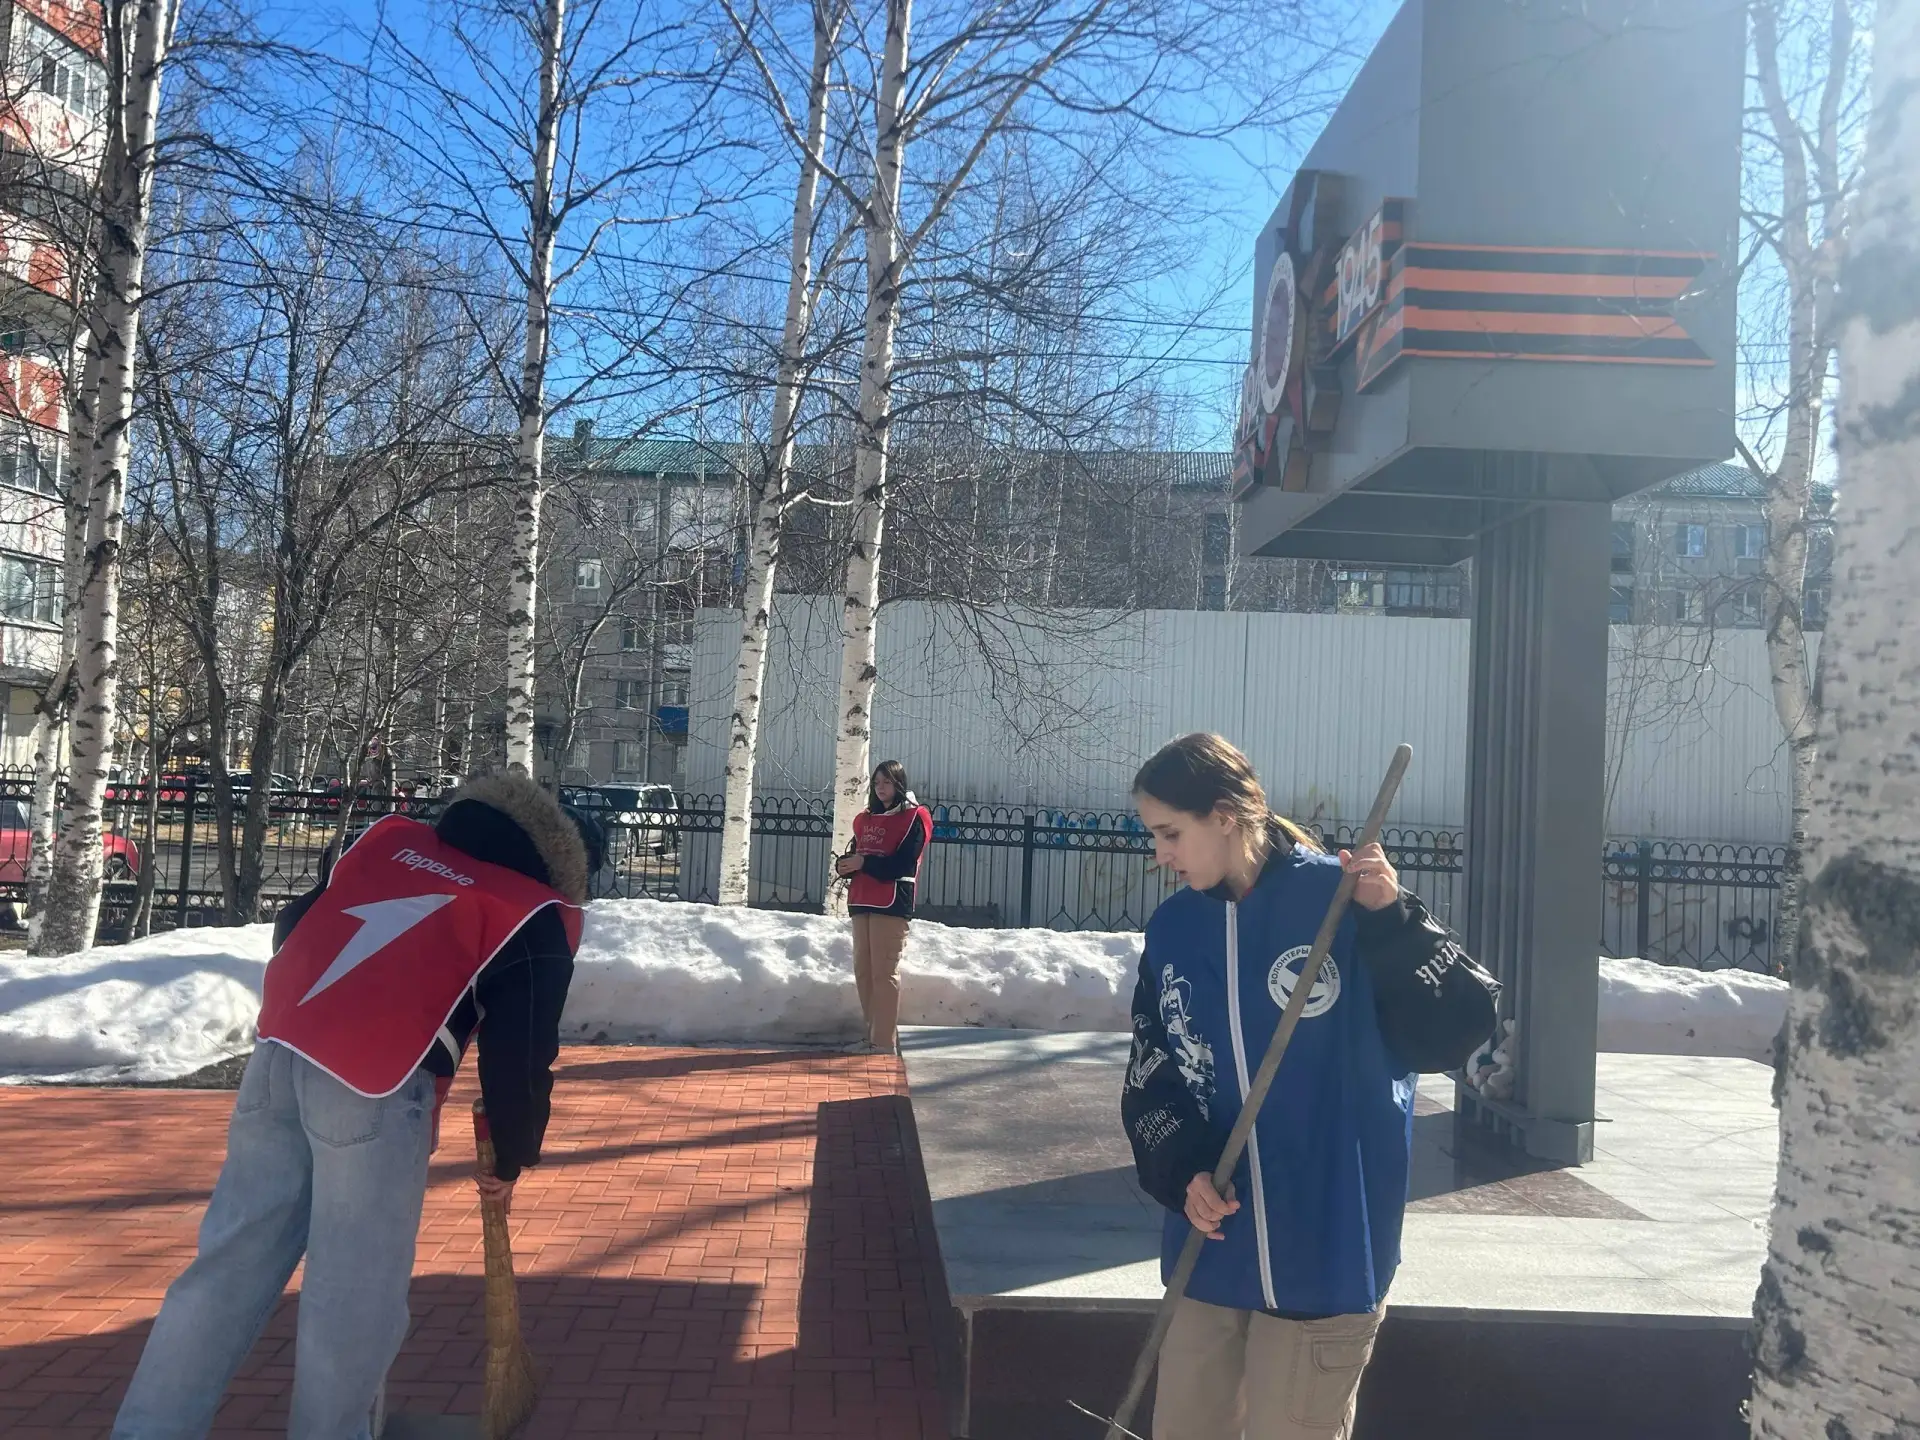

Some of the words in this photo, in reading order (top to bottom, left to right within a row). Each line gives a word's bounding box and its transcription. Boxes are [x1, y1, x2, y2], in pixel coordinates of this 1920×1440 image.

[1335, 212, 1381, 341] 1945
[391, 848, 475, 886] Первые
[1271, 947, 1309, 985] ВОЛОНТЕРЫ
[1323, 955, 1339, 980] БЕДЫ
